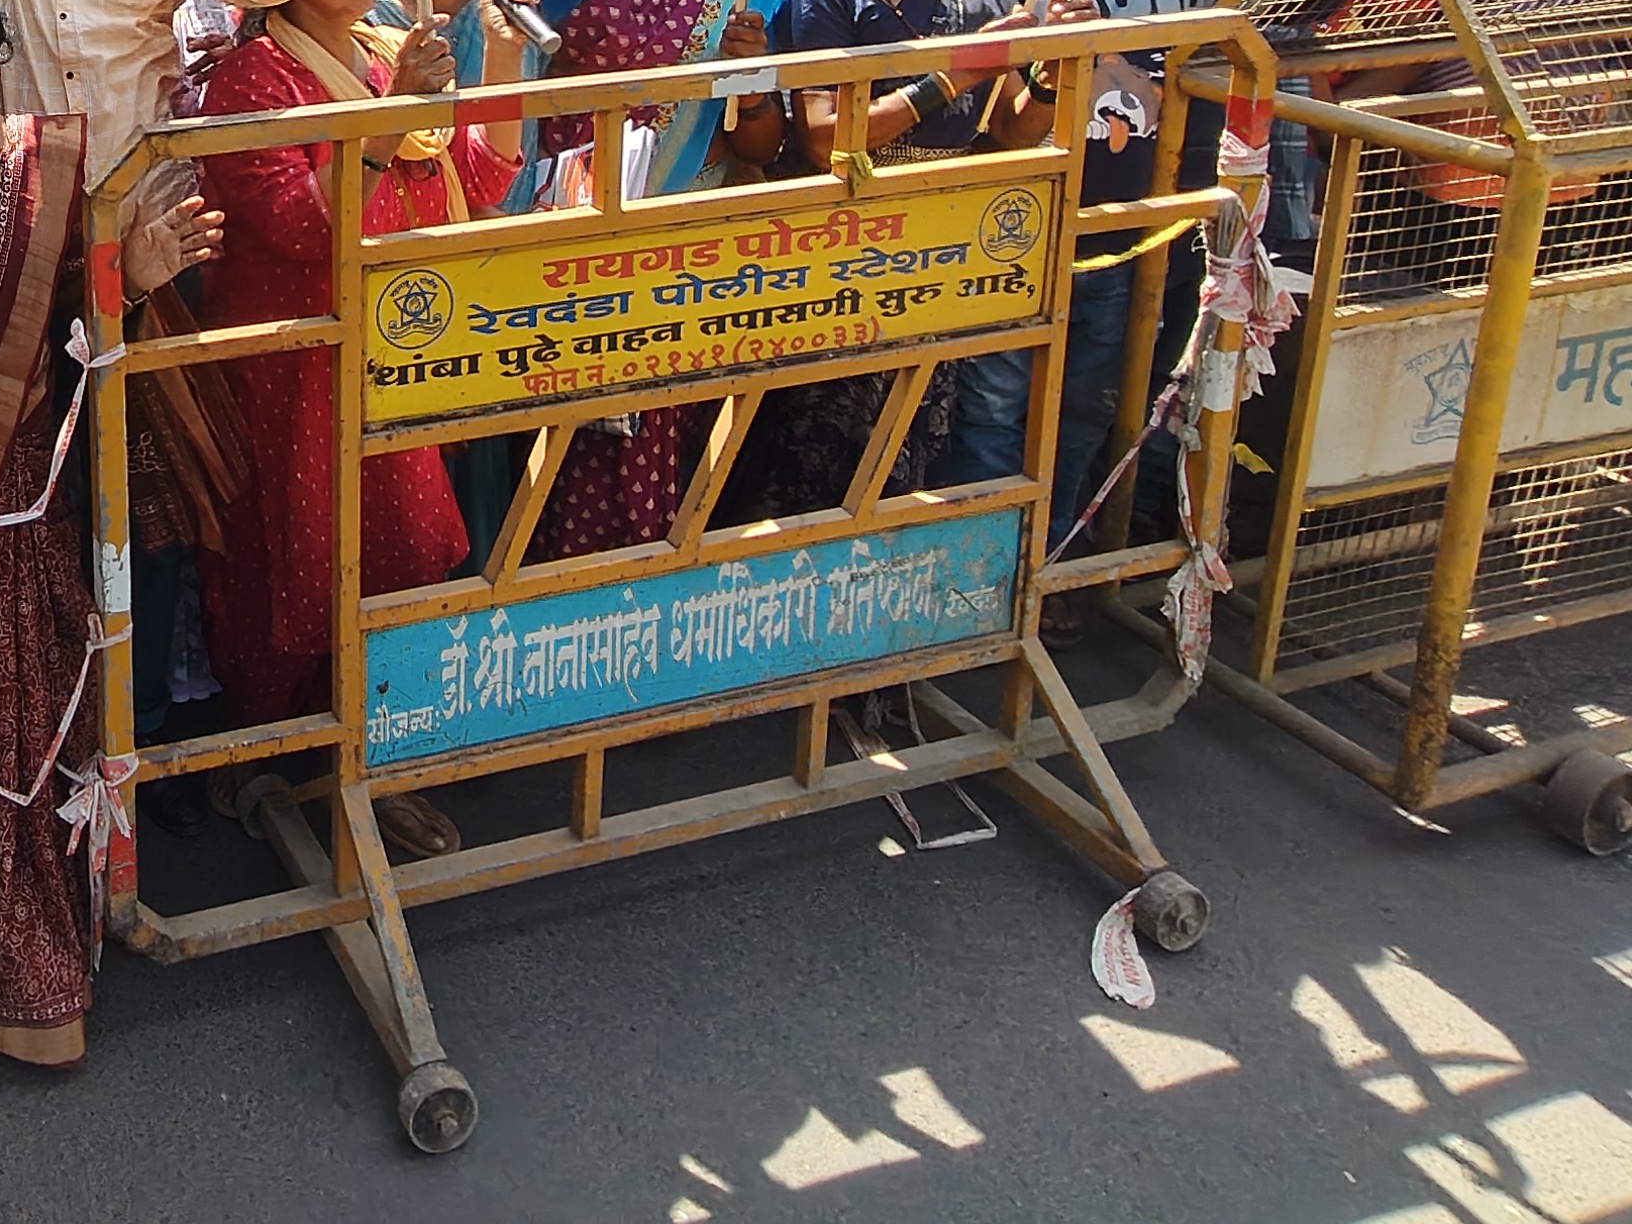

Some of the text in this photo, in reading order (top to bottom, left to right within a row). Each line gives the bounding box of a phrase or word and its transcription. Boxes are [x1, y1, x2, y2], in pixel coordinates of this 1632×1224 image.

[466, 242, 972, 336] रेवदंडा पोलीस स्टेशन
[542, 204, 908, 291] रायगड पोलीस
[495, 334, 563, 377] पुढे
[572, 320, 686, 356] वाहन
[698, 286, 862, 337] तपासणी
[522, 363, 579, 396] फोन
[367, 704, 441, 744] सौजन्य:
[671, 549, 819, 668] धर्माधिकारी
